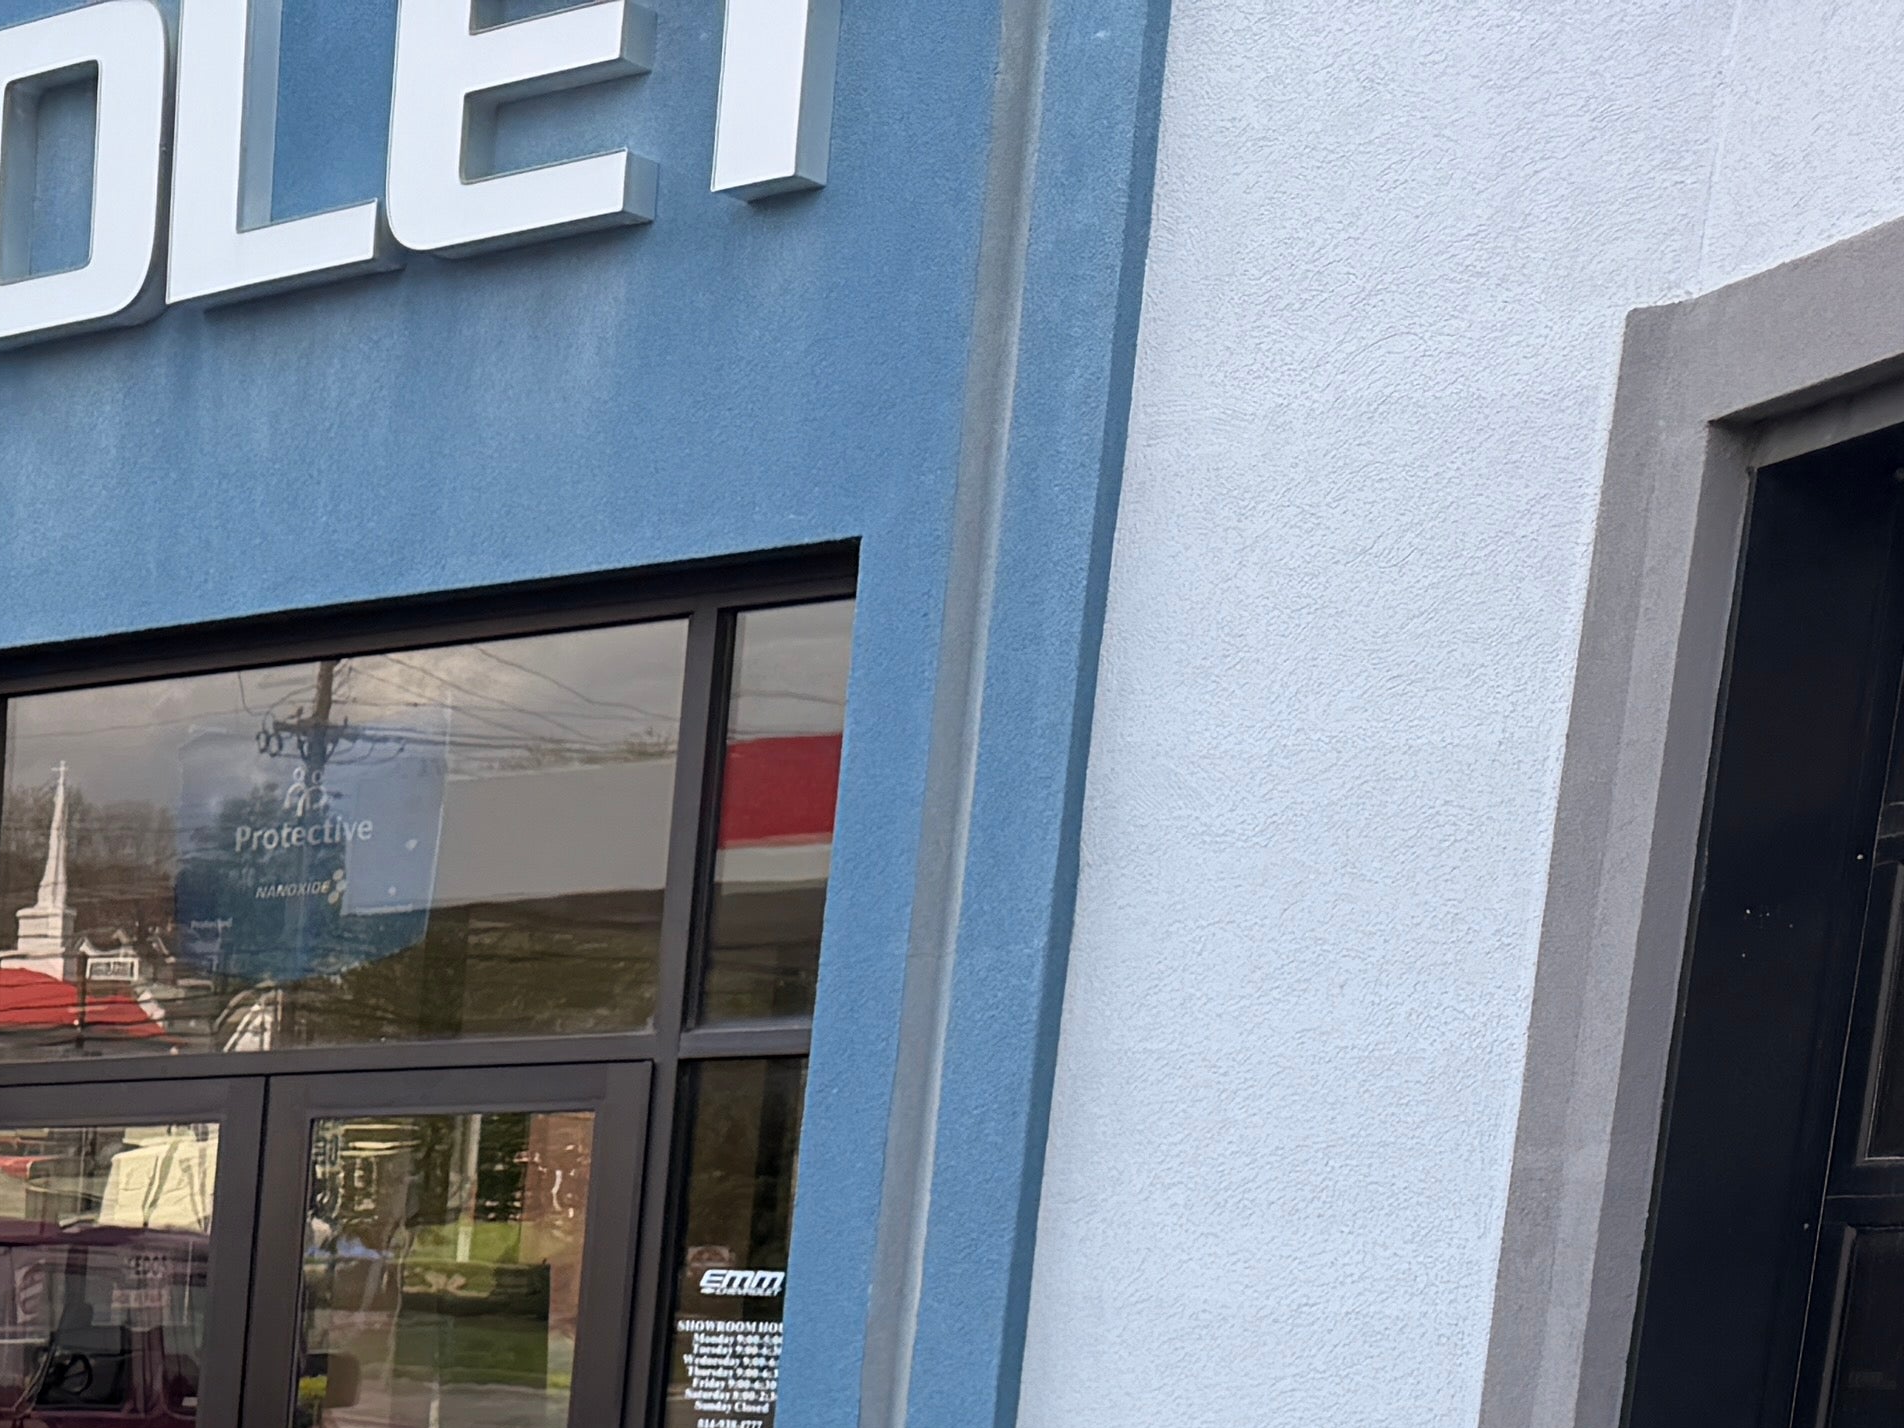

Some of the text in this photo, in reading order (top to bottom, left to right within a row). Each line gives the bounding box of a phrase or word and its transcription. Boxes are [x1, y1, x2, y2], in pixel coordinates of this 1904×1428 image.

[234, 818, 374, 852] Protective
[677, 1320, 757, 1333] SHOWROOM
[693, 1333, 734, 1346] Monday
[692, 1344, 732, 1358] Tuesday
[682, 1354, 740, 1368] Wednesday
[686, 1366, 733, 1379] Thursday
[692, 1377, 726, 1390] Friday
[684, 1388, 731, 1403] Saturday
[694, 1400, 770, 1414] Sunday Closed
